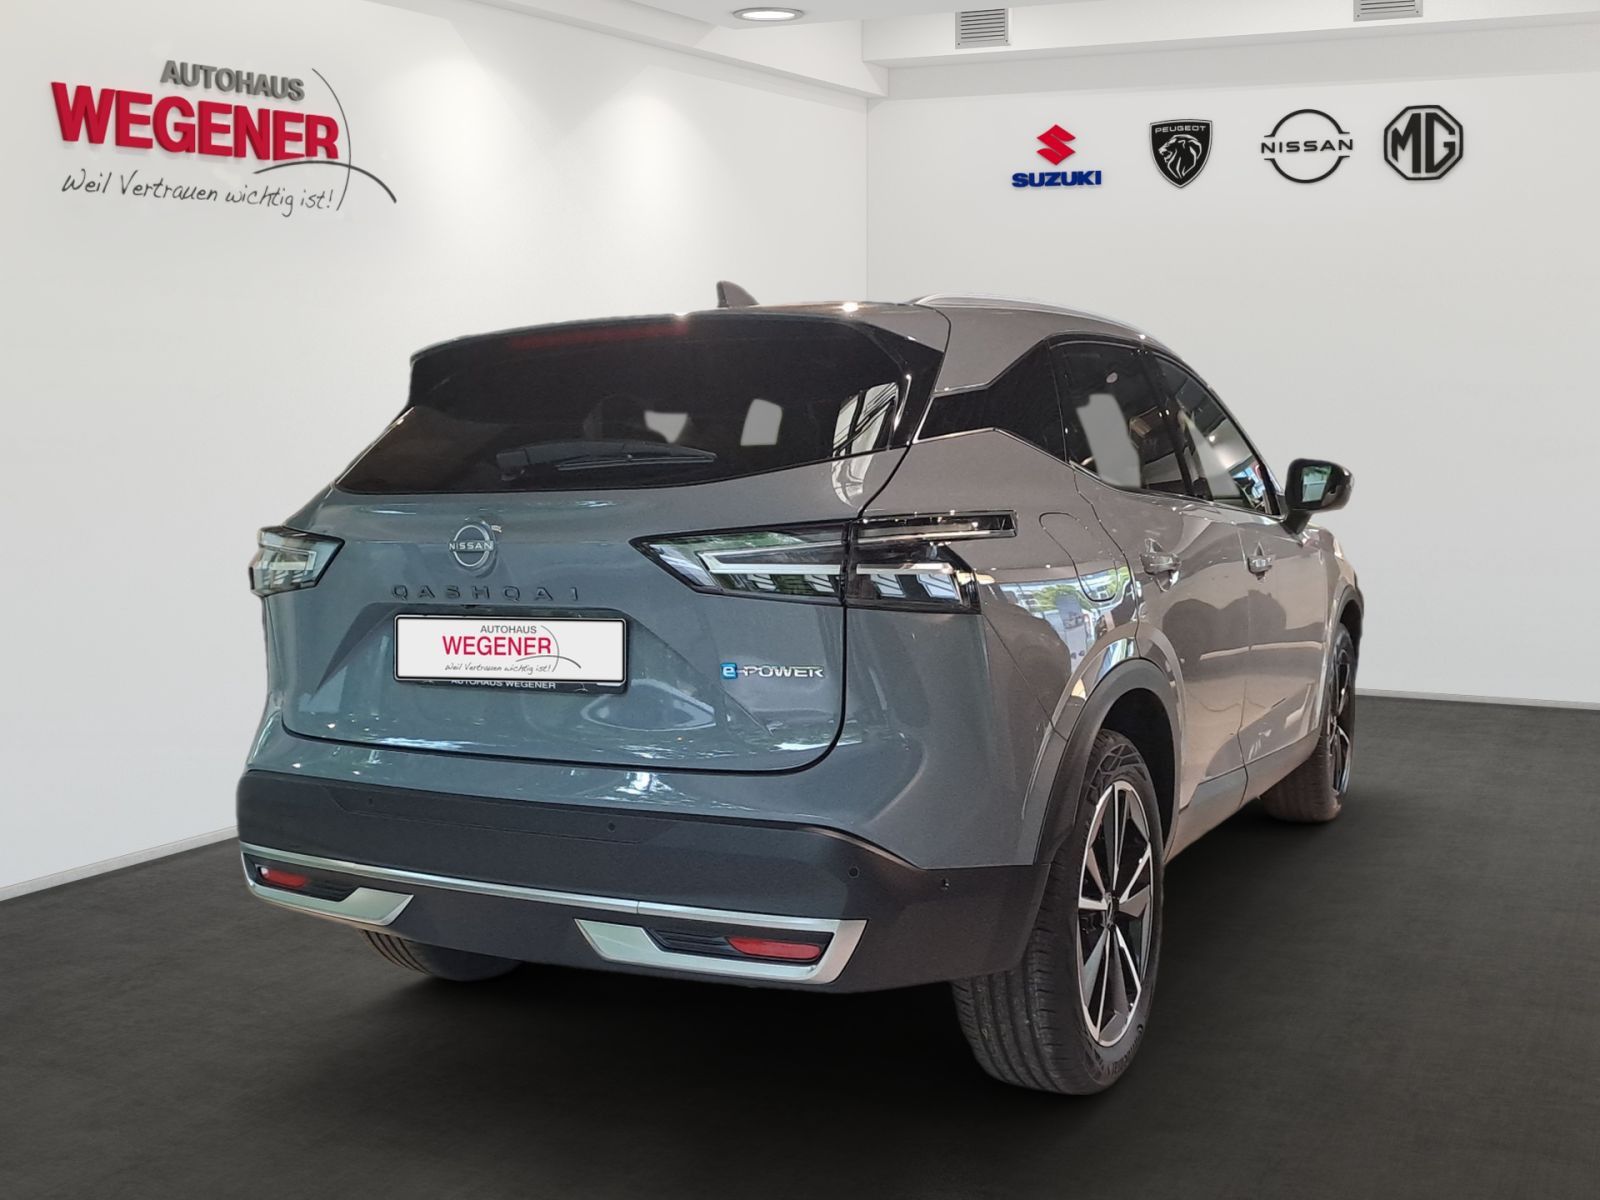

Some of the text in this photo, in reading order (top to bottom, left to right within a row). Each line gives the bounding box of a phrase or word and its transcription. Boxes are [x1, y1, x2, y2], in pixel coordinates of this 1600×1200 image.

[160, 60, 305, 101] AUTOHAUS
[51, 81, 339, 161] WEGENER
[1154, 125, 1207, 134] PEUGEOT
[1261, 138, 1354, 155] NISSAN
[1391, 111, 1456, 174] MG
[1012, 170, 1102, 188] SUZUKI
[62, 168, 333, 217] Weil Vertrauen wichtig ist!
[449, 540, 494, 551] NISSAN
[392, 585, 579, 602] QASHQAI
[480, 625, 537, 634] AUTOHAUS
[442, 635, 552, 656] WEGENER
[444, 661, 463, 671] Weil
[464, 662, 502, 672] Vertrauen
[504, 663, 534, 675] wichtig
[505, 681, 557, 689] WEGENER
